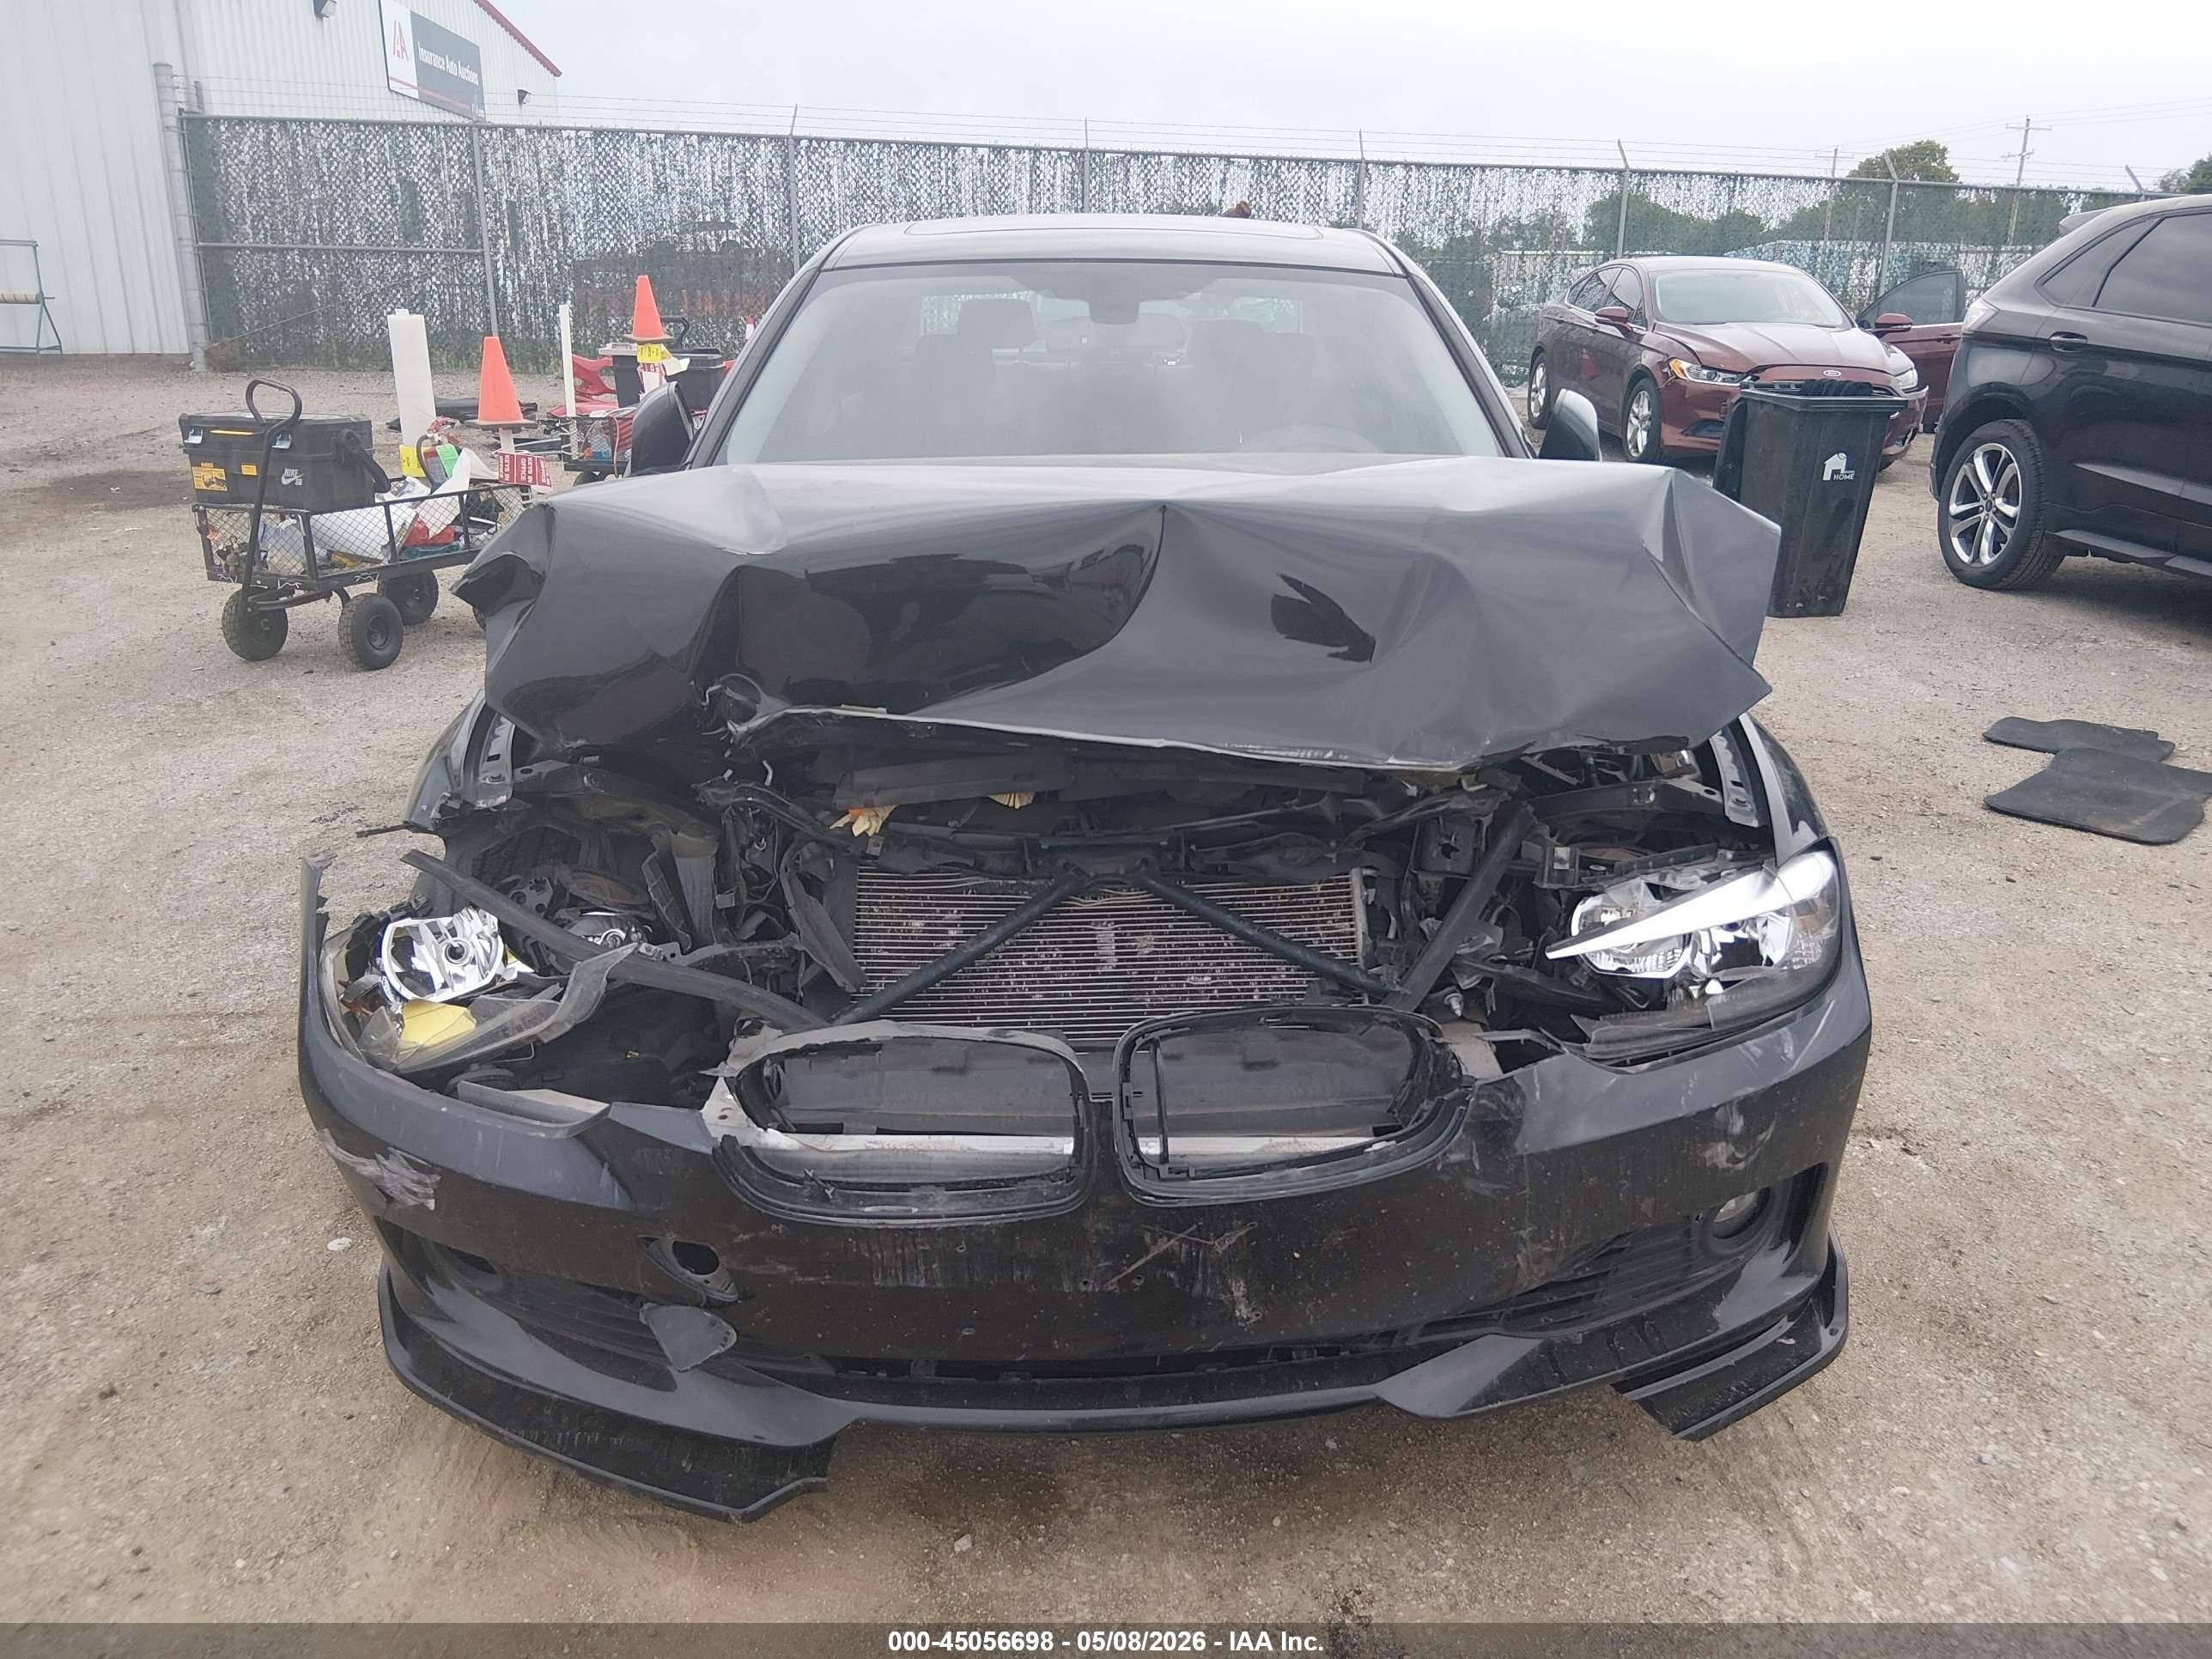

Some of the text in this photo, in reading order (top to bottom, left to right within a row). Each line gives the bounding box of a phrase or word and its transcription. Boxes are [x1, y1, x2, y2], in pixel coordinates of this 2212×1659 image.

[417, 40, 479, 87] Insurance Auto Auctions
[284, 468, 300, 477] NIKE
[504, 473, 510, 482] IN
[527, 474, 533, 483] IN
